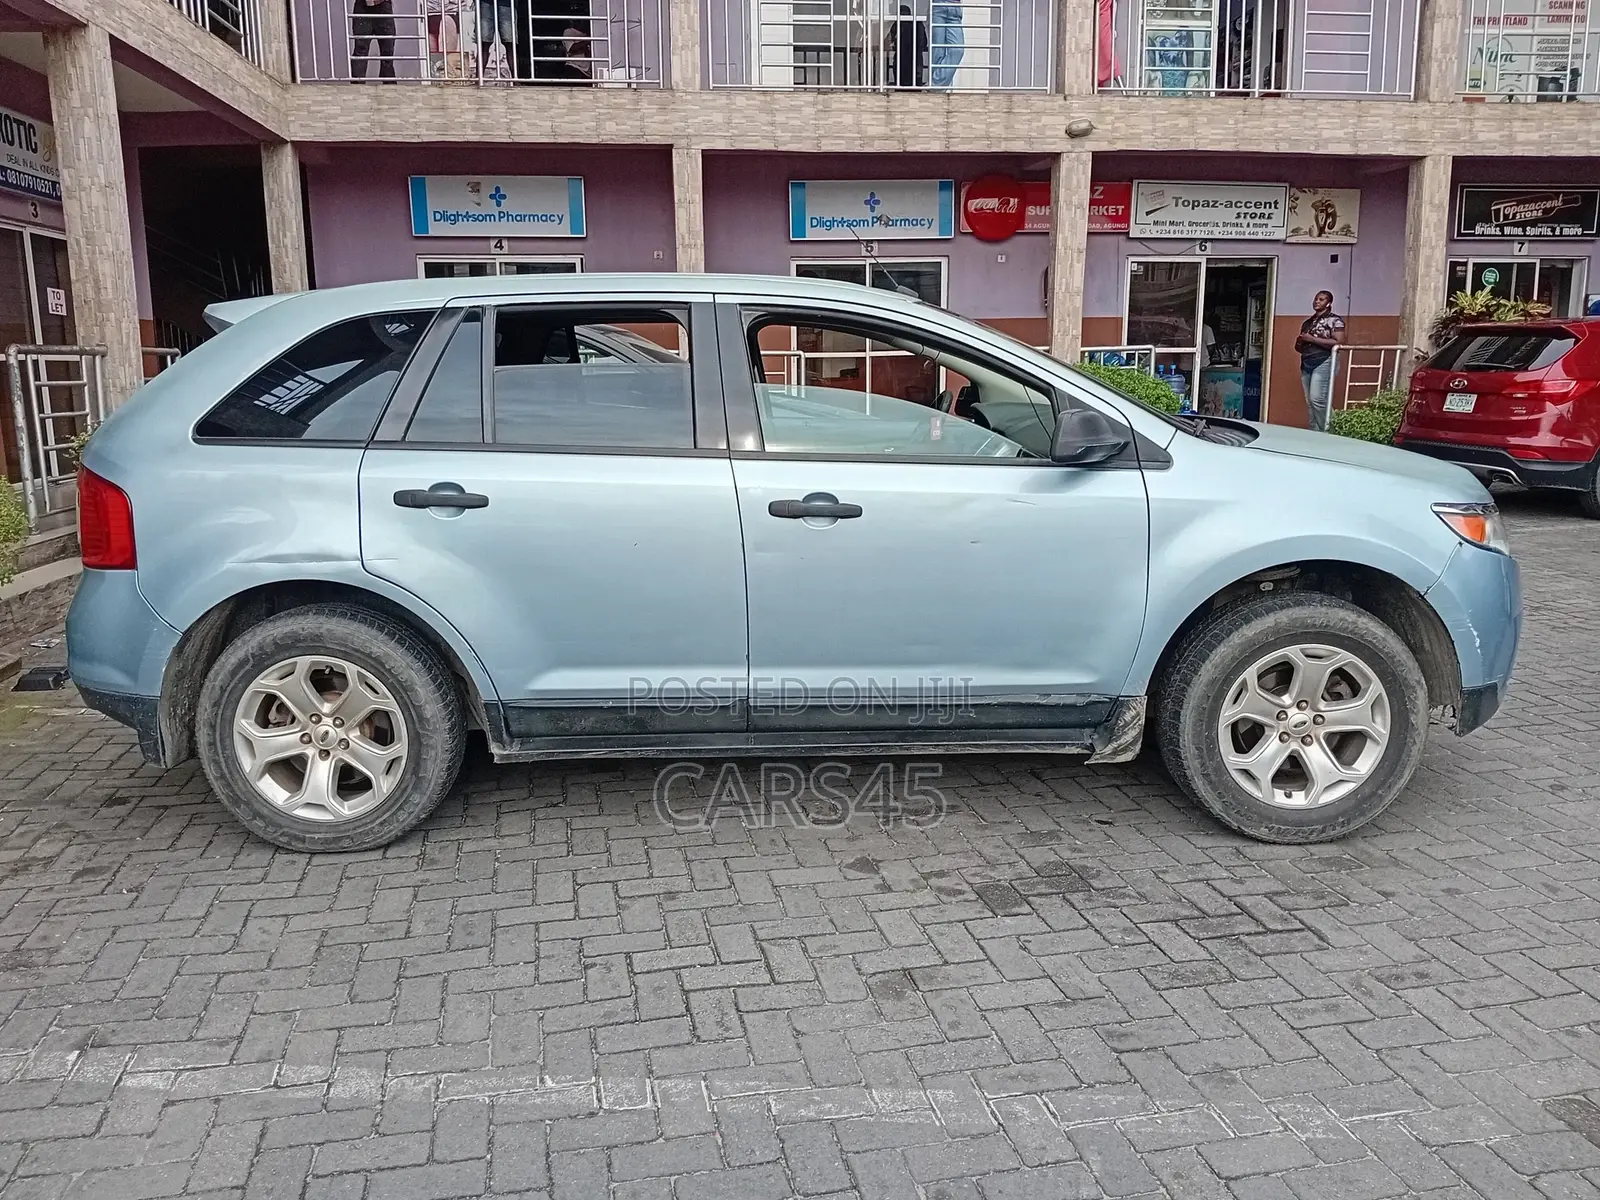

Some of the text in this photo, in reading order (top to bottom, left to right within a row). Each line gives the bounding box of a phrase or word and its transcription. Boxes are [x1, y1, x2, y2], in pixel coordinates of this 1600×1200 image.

[1548, 1, 1586, 10] SCANNNG
[1172, 196, 1280, 211] Topaz-accent
[30, 201, 39, 219] 3
[1235, 211, 1274, 220] STORE
[1515, 209, 1543, 220] STORE
[498, 210, 564, 226] Pharmacy
[1554, 226, 1561, 235] &
[1562, 227, 1583, 236] more
[493, 239, 505, 251] 4
[865, 241, 875, 254] 5
[1198, 240, 1208, 252] 6
[1517, 242, 1526, 253] 7
[51, 290, 61, 301] TO
[50, 302, 64, 314] LET
